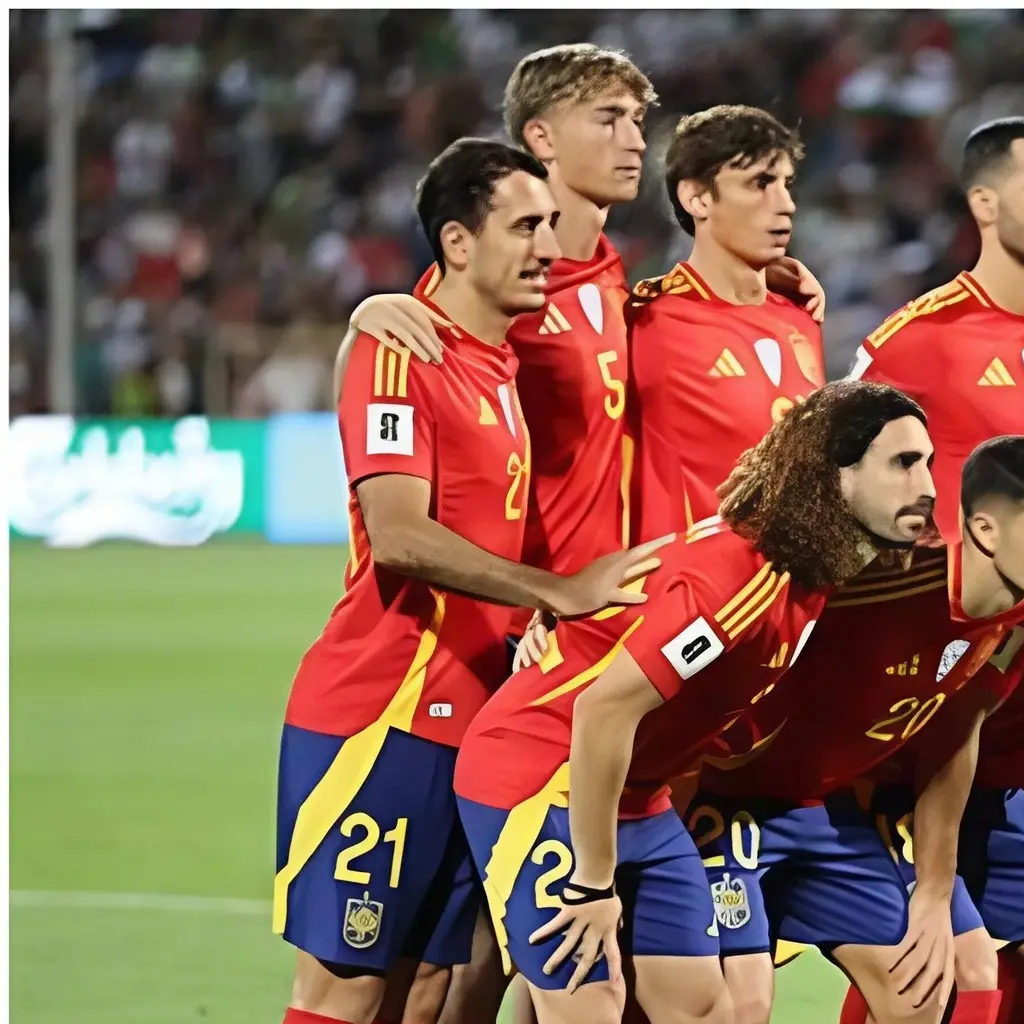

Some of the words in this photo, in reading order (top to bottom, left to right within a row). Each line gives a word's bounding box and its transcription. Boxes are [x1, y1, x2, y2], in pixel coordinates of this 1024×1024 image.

[597, 350, 626, 420] 5
[865, 692, 946, 742] 20
[334, 812, 408, 888] 21
